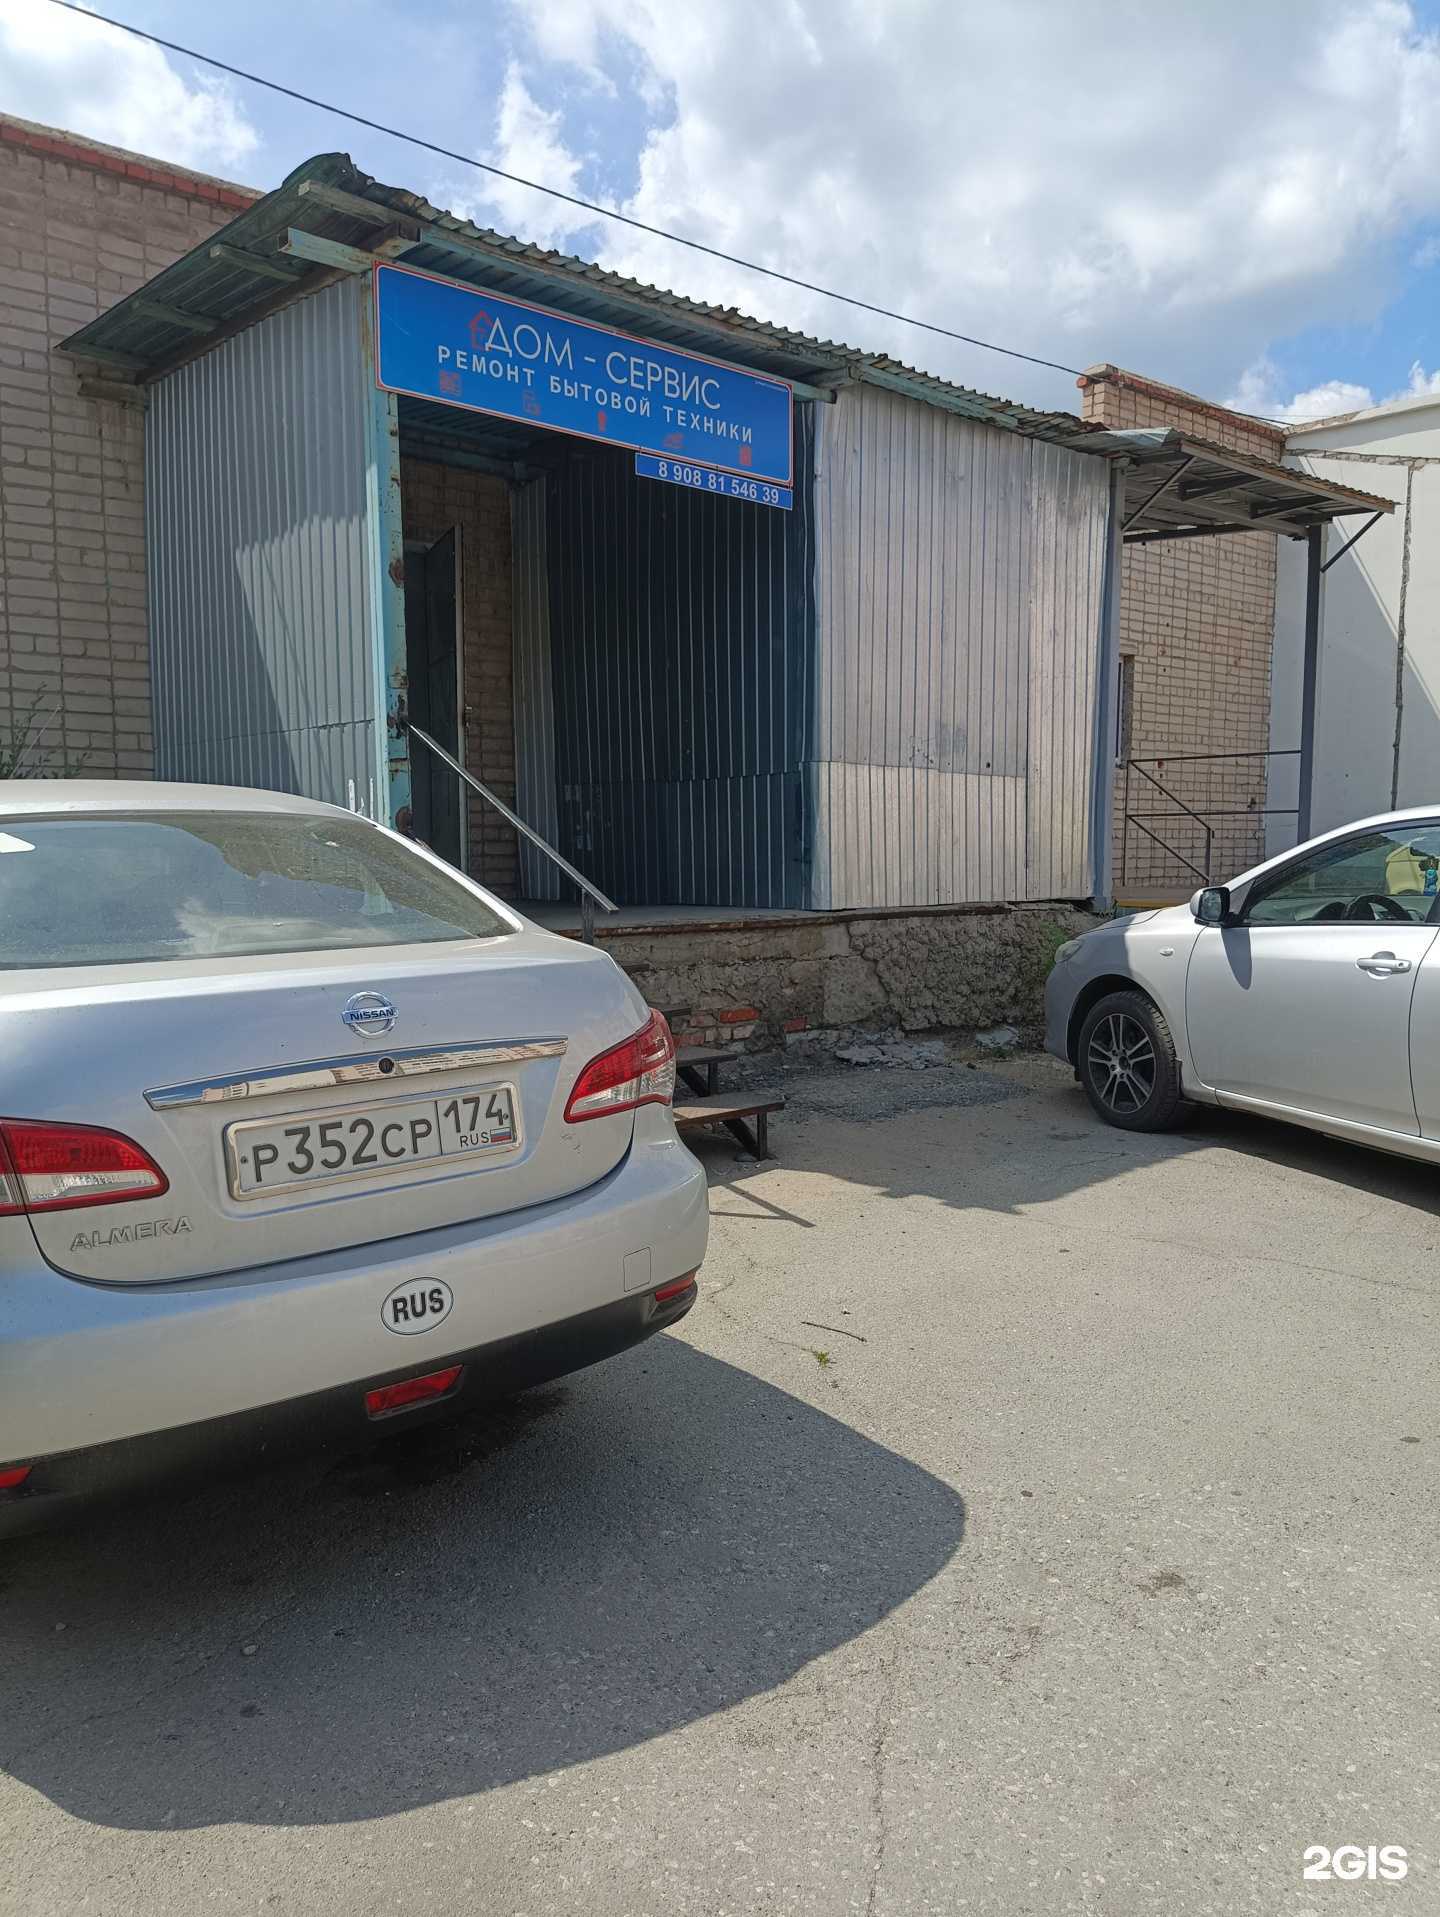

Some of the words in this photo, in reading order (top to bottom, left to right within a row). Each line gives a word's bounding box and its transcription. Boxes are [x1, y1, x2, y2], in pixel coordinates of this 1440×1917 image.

[484, 316, 574, 371] ДОМ
[605, 350, 722, 411] СЕРВИС
[437, 344, 536, 387] РЕМОНТ
[550, 374, 651, 418] БЫТОВОЙ
[662, 405, 753, 444] ТЕХНИКИ
[658, 461, 669, 478] 8
[673, 464, 702, 486] 908
[708, 473, 725, 492] 81
[731, 479, 757, 499] 546
[762, 486, 779, 504] 39
[350, 1008, 394, 1021] NISSAN
[442, 1093, 505, 1135] 174
[459, 1131, 490, 1148] RUS
[70, 1215, 193, 1252] ALMERA
[392, 1287, 445, 1323] RUS
